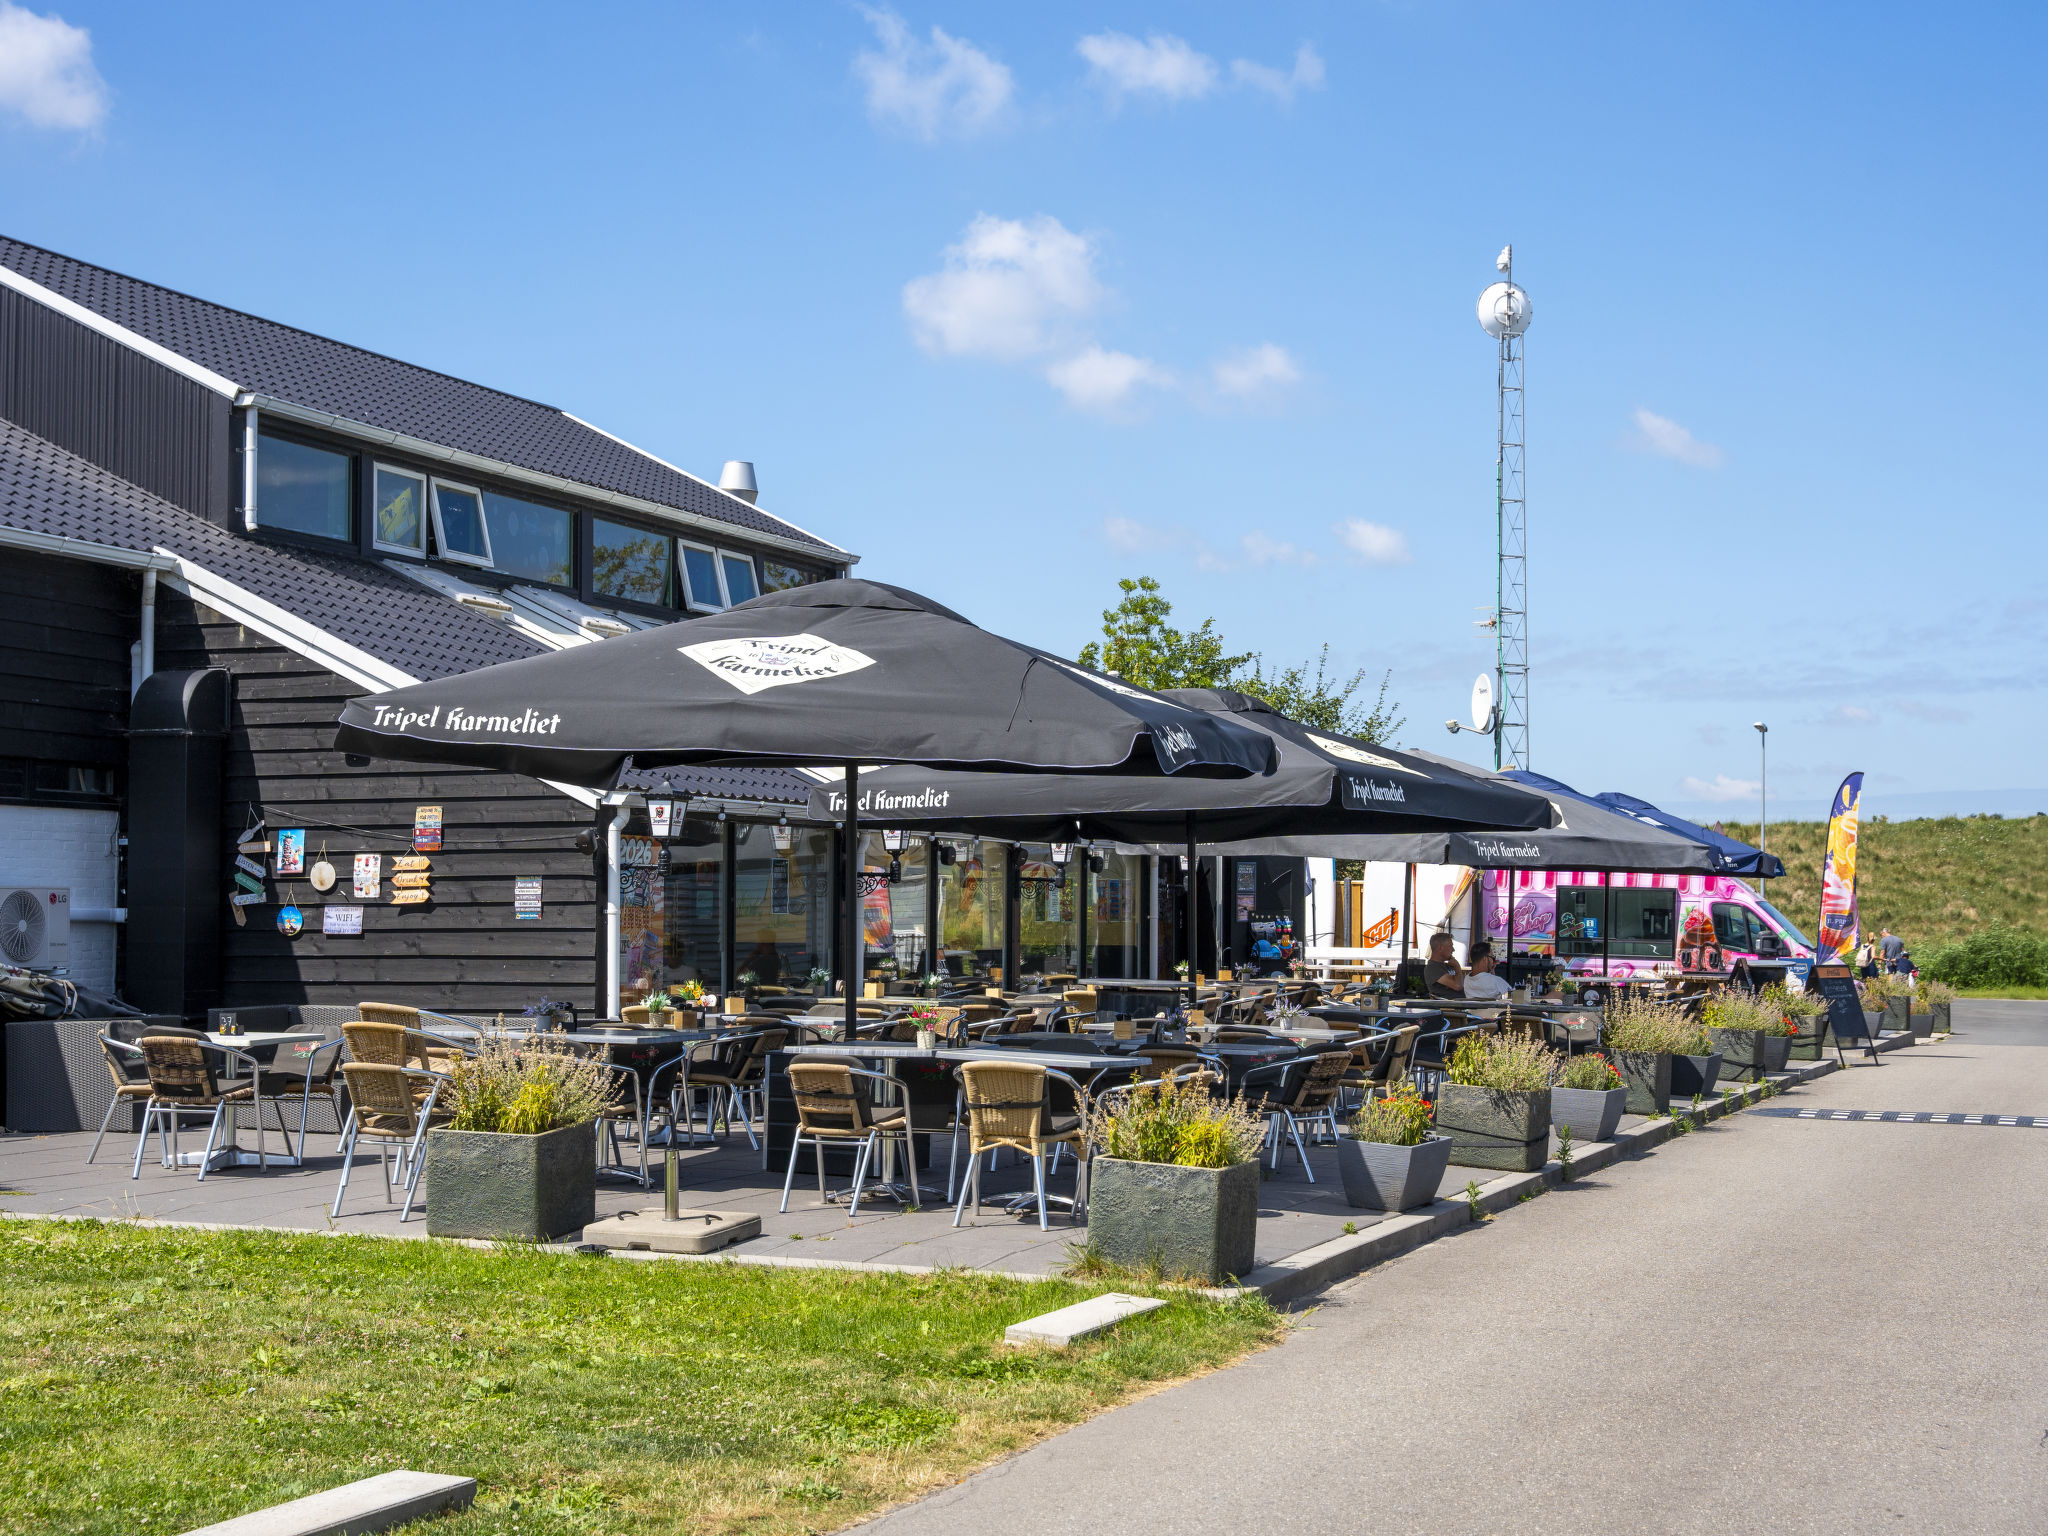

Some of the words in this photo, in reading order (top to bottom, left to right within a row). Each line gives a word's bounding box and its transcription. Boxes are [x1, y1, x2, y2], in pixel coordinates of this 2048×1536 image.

[740, 639, 832, 656] Tripel
[708, 654, 839, 677] Karmeliet
[373, 705, 440, 732] Tripel
[444, 707, 561, 735] Karmeliet
[829, 790, 872, 812] Triel
[875, 786, 950, 810] Karmeliet
[1349, 777, 1371, 806] Tripel
[1370, 779, 1406, 803] Karmeliet
[619, 838, 652, 866] 2026
[1474, 840, 1500, 861] Tripel
[1499, 841, 1541, 858] Karmeliet
[397, 859, 414, 867] Eat
[396, 875, 418, 884] Drink
[57, 894, 67, 903] LG
[335, 913, 353, 922] WIFI
[1513, 912, 1553, 937] Shop
